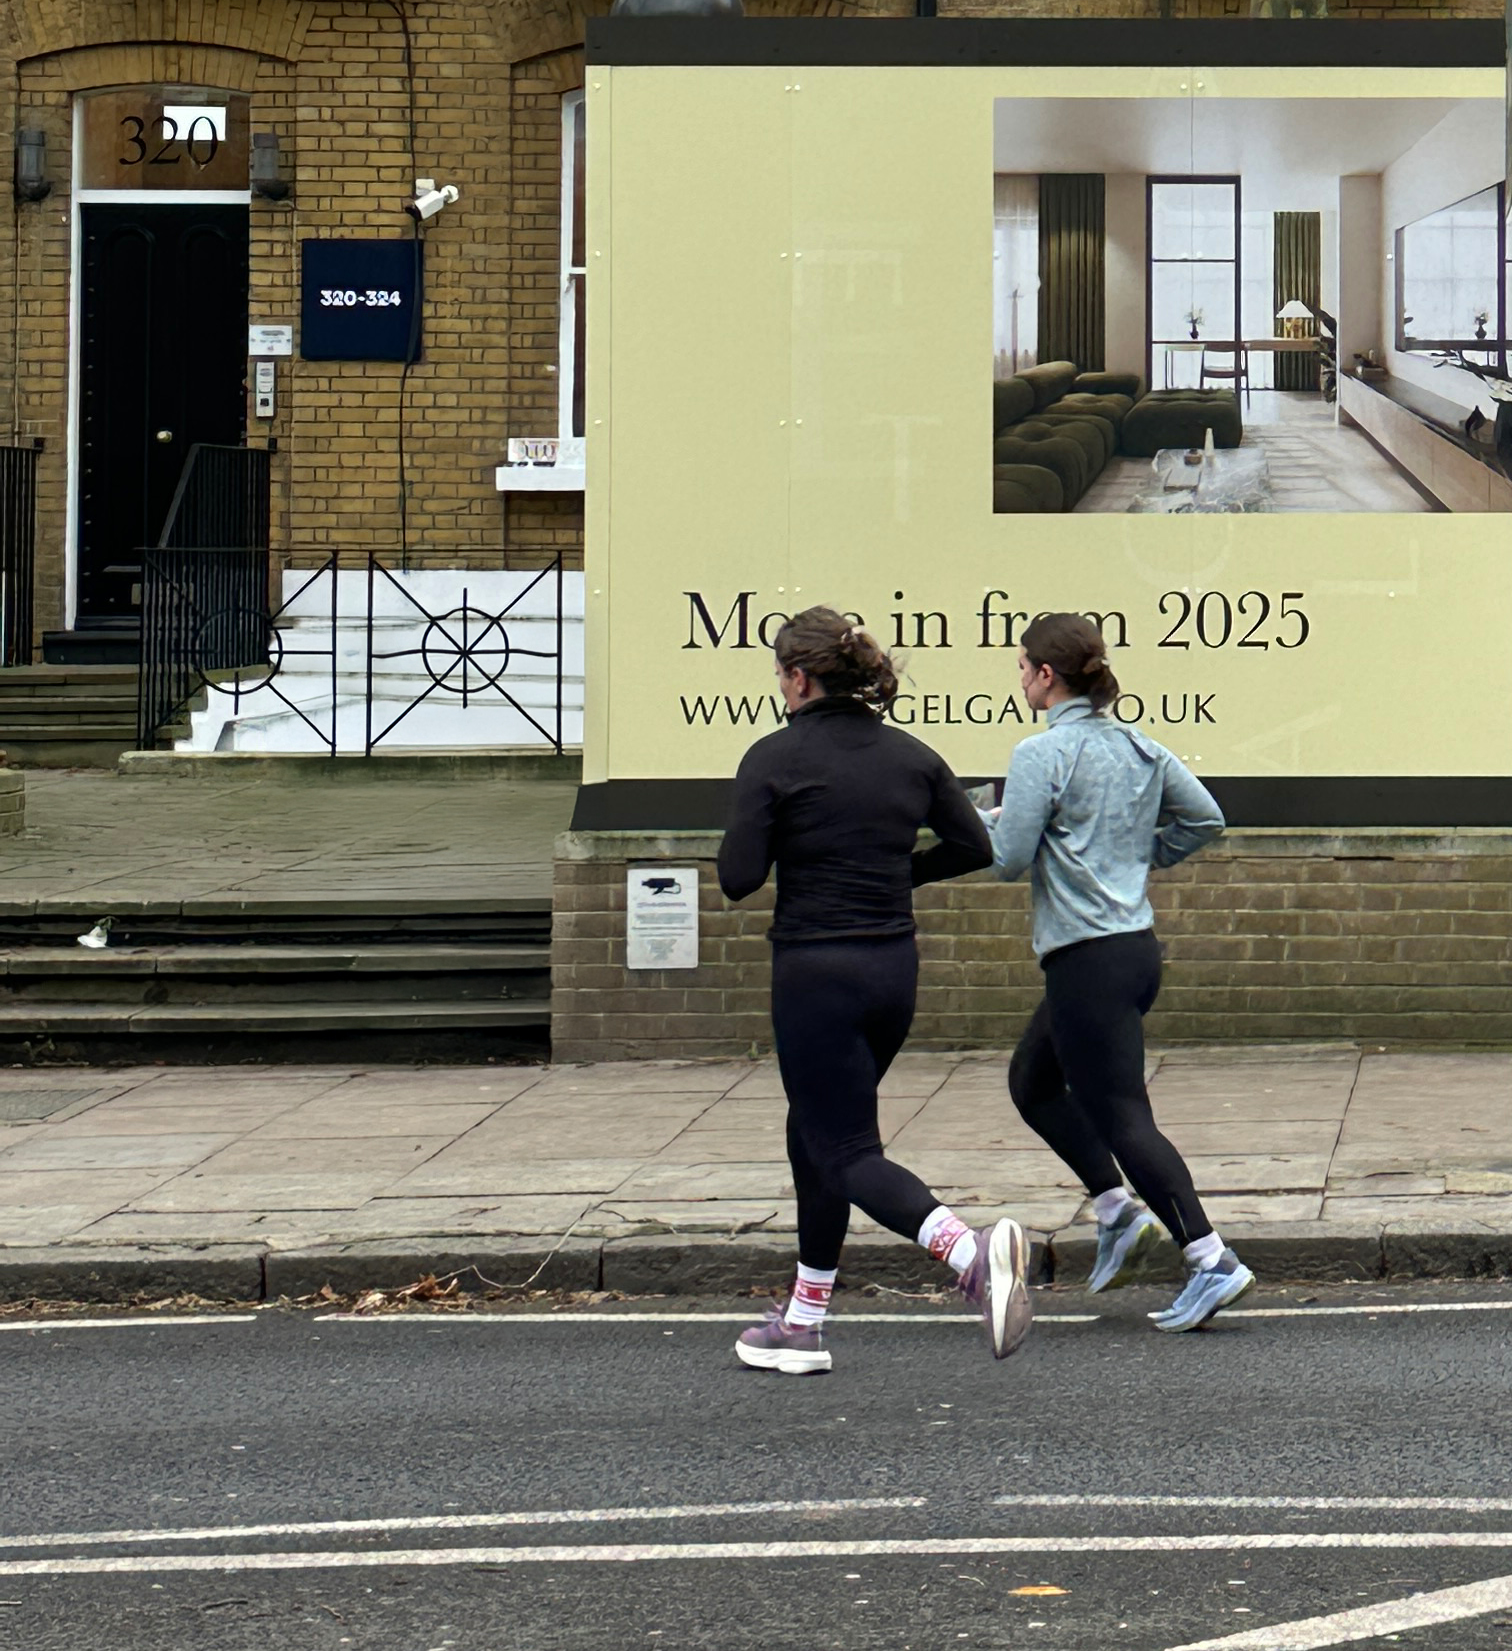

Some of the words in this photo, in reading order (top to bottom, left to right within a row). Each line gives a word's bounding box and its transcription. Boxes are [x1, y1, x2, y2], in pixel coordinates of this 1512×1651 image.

[119, 115, 219, 166] 320
[320, 289, 402, 307] 320-324
[681, 591, 865, 649] Mo
[890, 590, 953, 648] in
[976, 590, 1131, 648] frm
[1157, 591, 1310, 651] 2025
